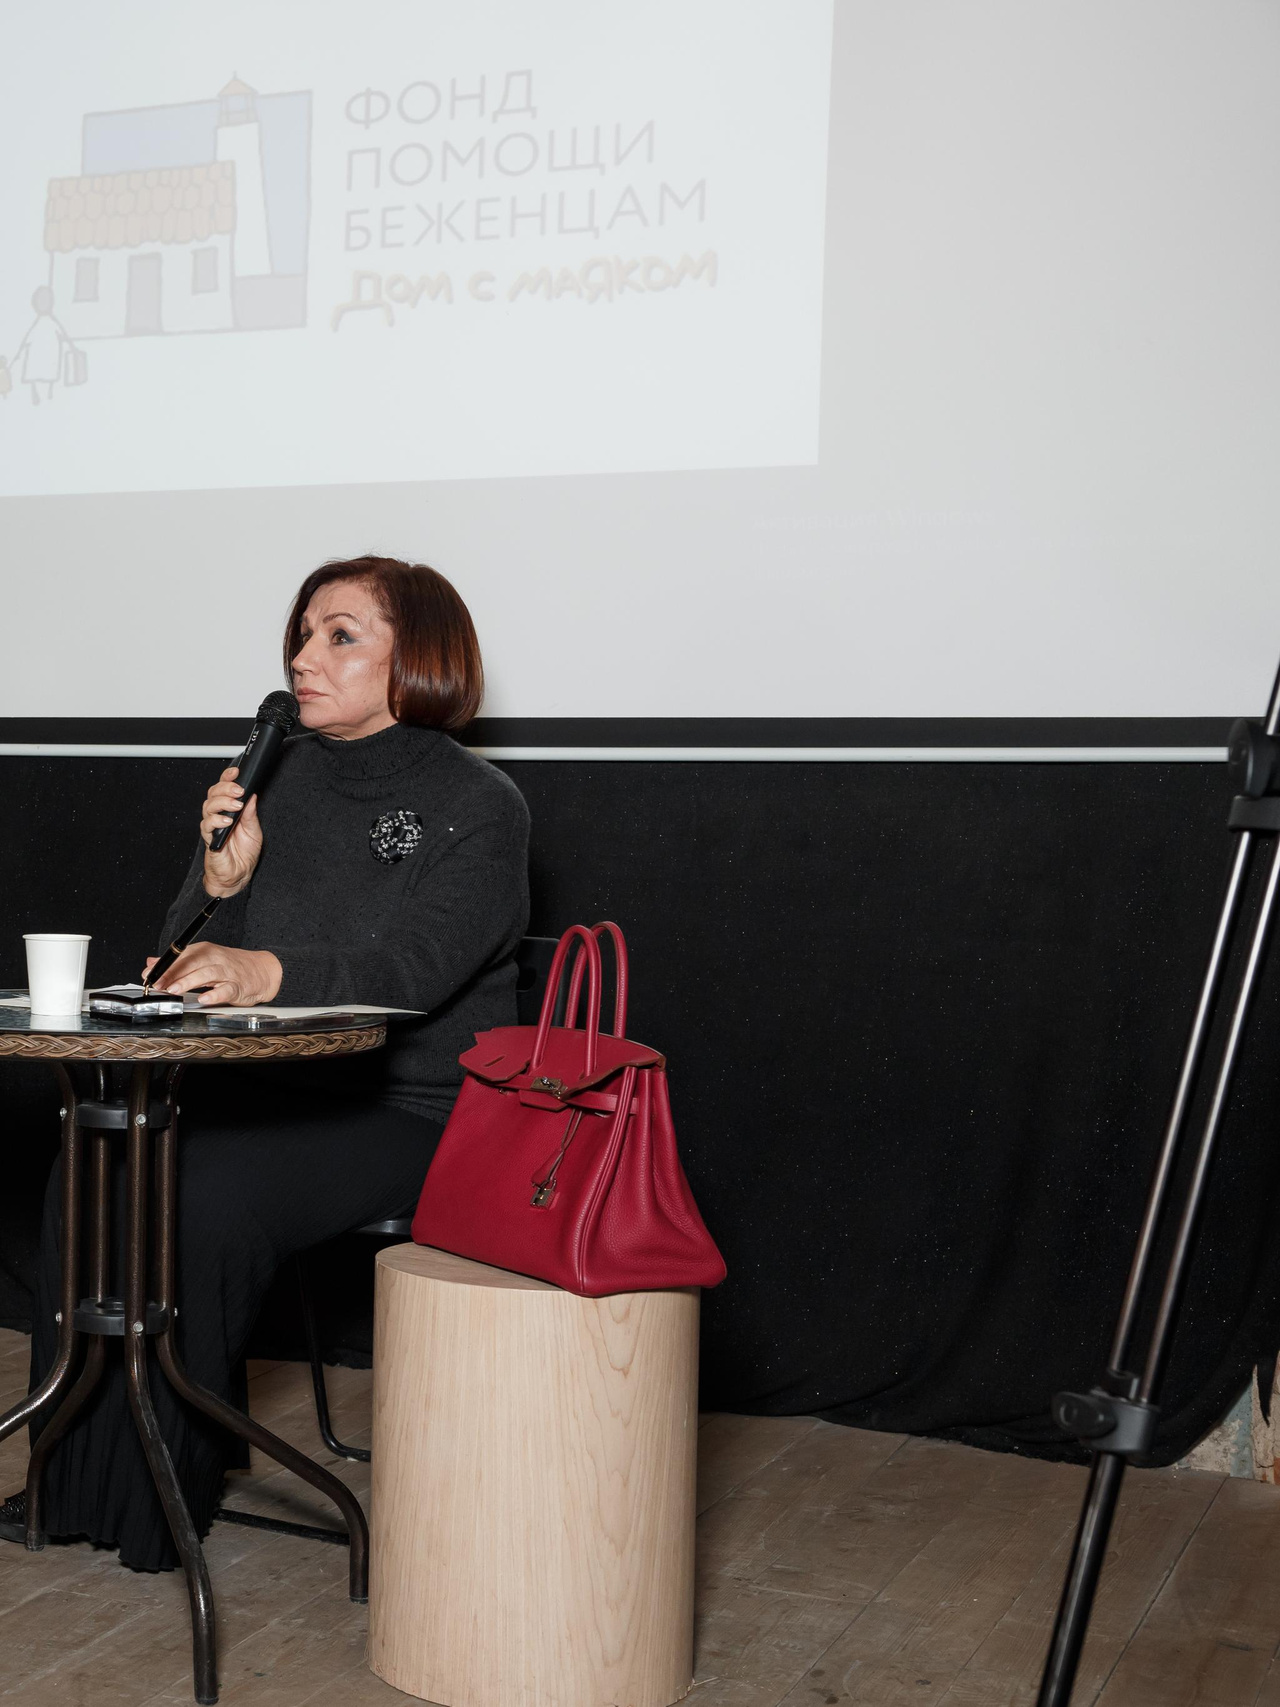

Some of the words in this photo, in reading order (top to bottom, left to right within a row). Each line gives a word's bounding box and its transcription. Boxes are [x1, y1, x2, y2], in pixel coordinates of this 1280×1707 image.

[344, 68, 538, 130] ФОНД
[346, 118, 655, 191] ПОМОЩИ
[343, 178, 708, 251] БЕЖЕНЦАМ
